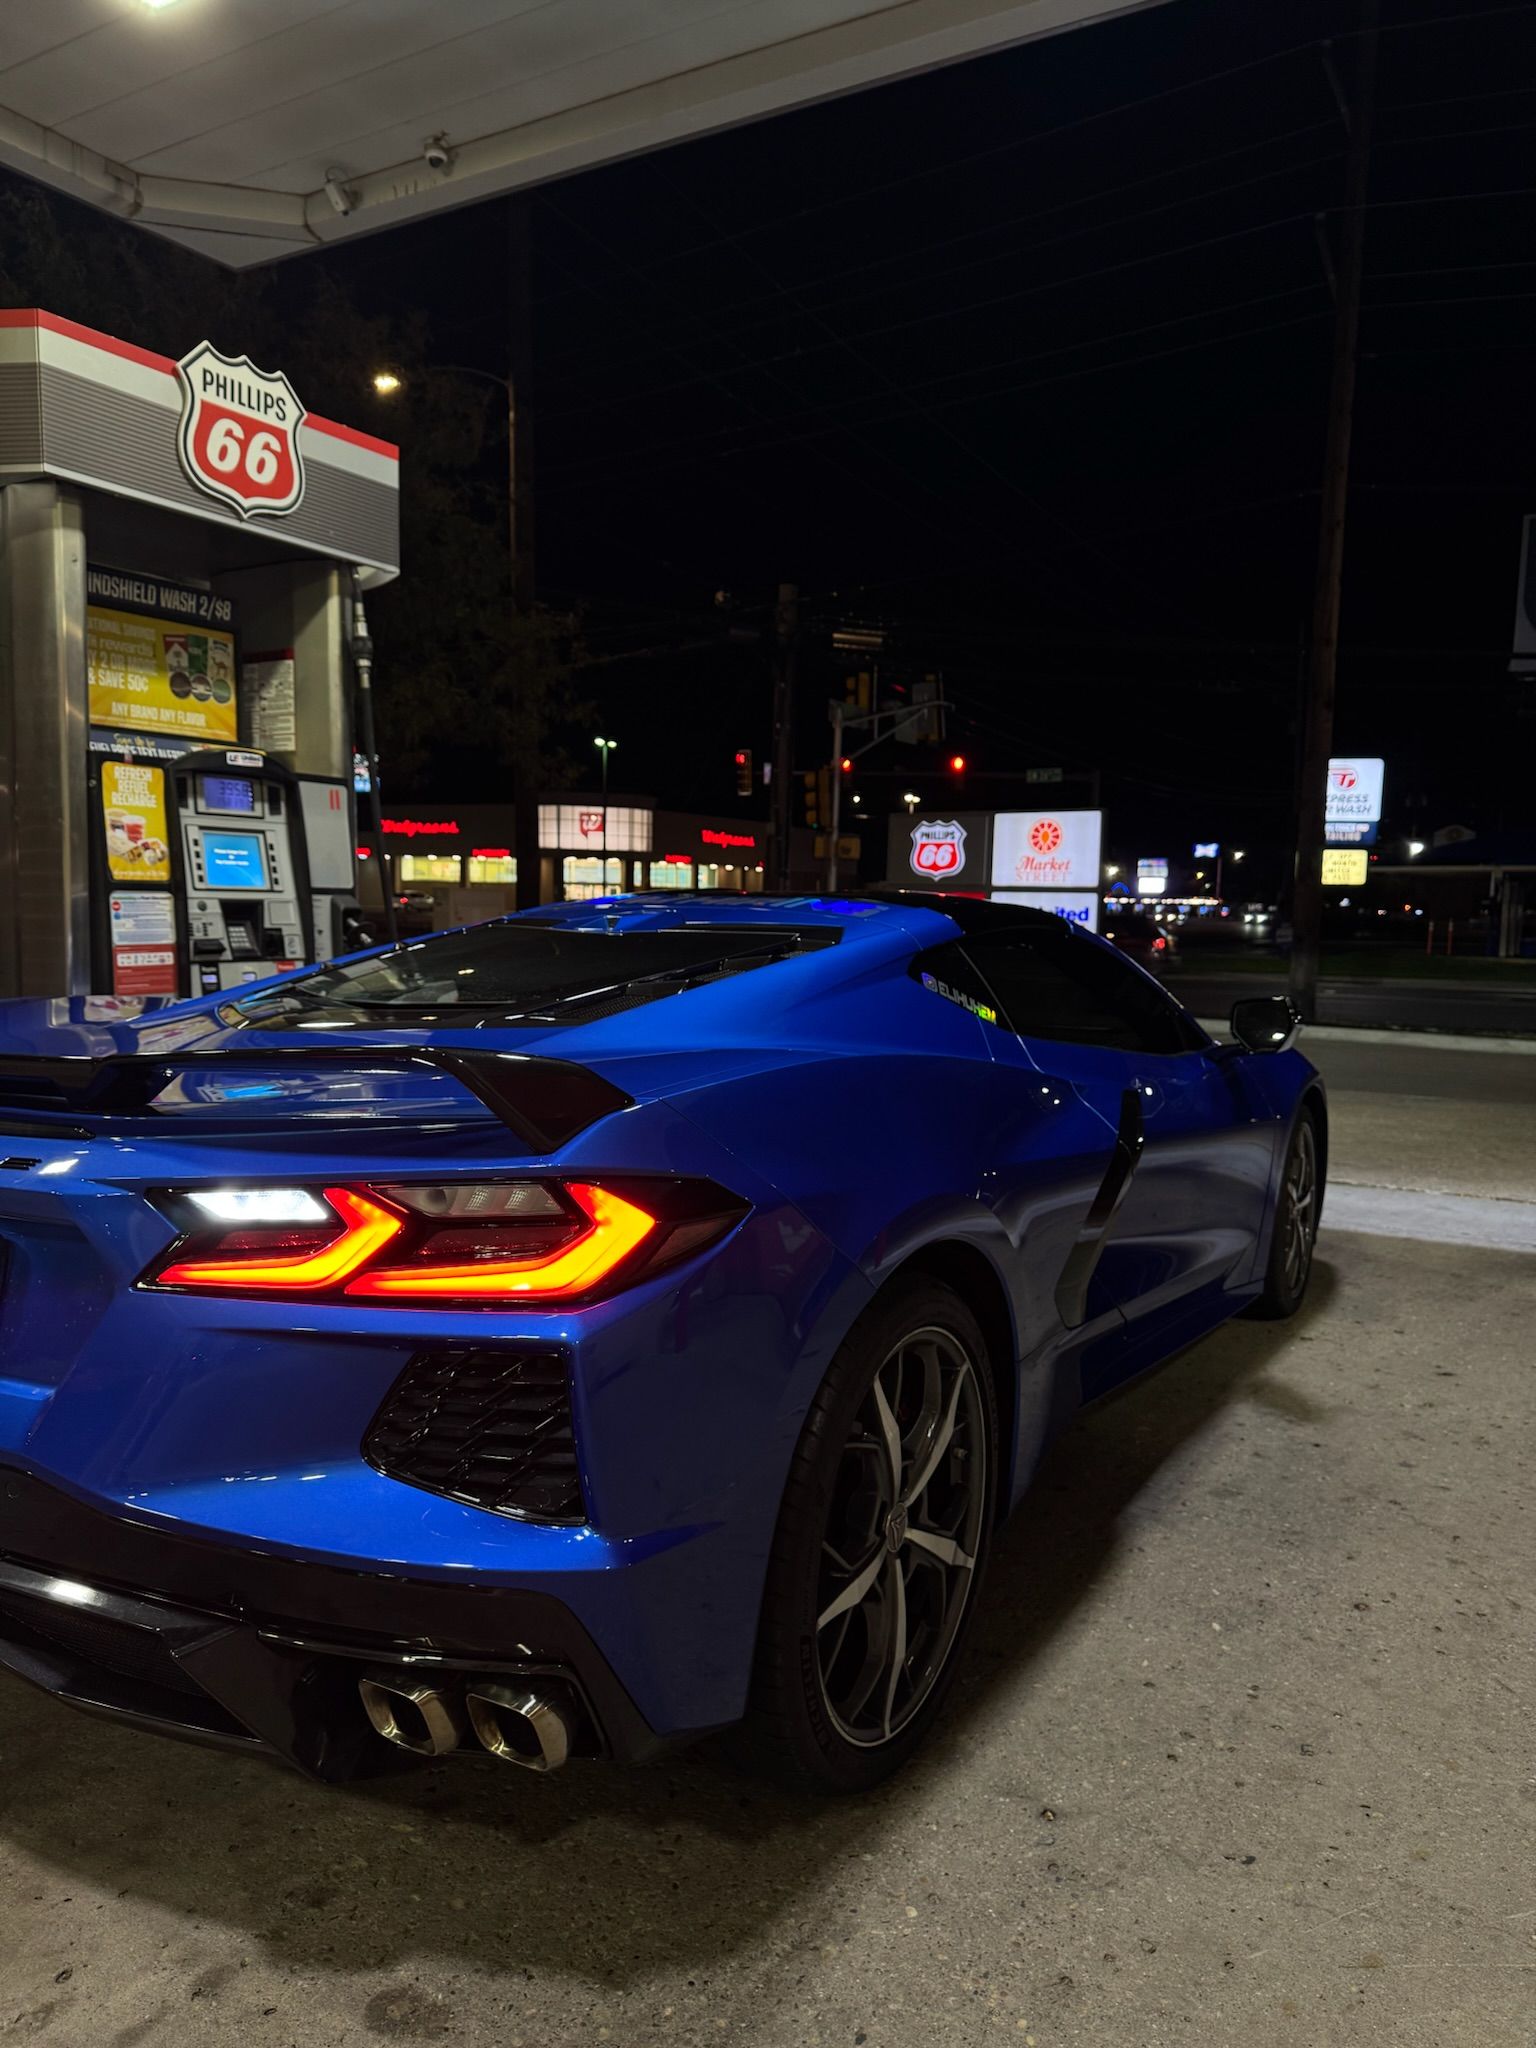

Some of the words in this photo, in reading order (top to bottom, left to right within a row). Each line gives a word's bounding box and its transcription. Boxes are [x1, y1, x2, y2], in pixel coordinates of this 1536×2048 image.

[202, 367, 287, 421] PHILLIPS
[206, 418, 283, 484] 66
[88, 571, 157, 606] INDSHIELD
[160, 586, 197, 613] WASH
[199, 595, 231, 621] 2/$8
[98, 669, 126, 689] SAVE
[111, 701, 129, 716] ANY
[159, 708, 177, 723] ANY
[920, 831, 955, 841] PHILLIPS
[919, 846, 953, 867] 66
[1016, 856, 1072, 871] Market
[1016, 871, 1071, 882] STREET
